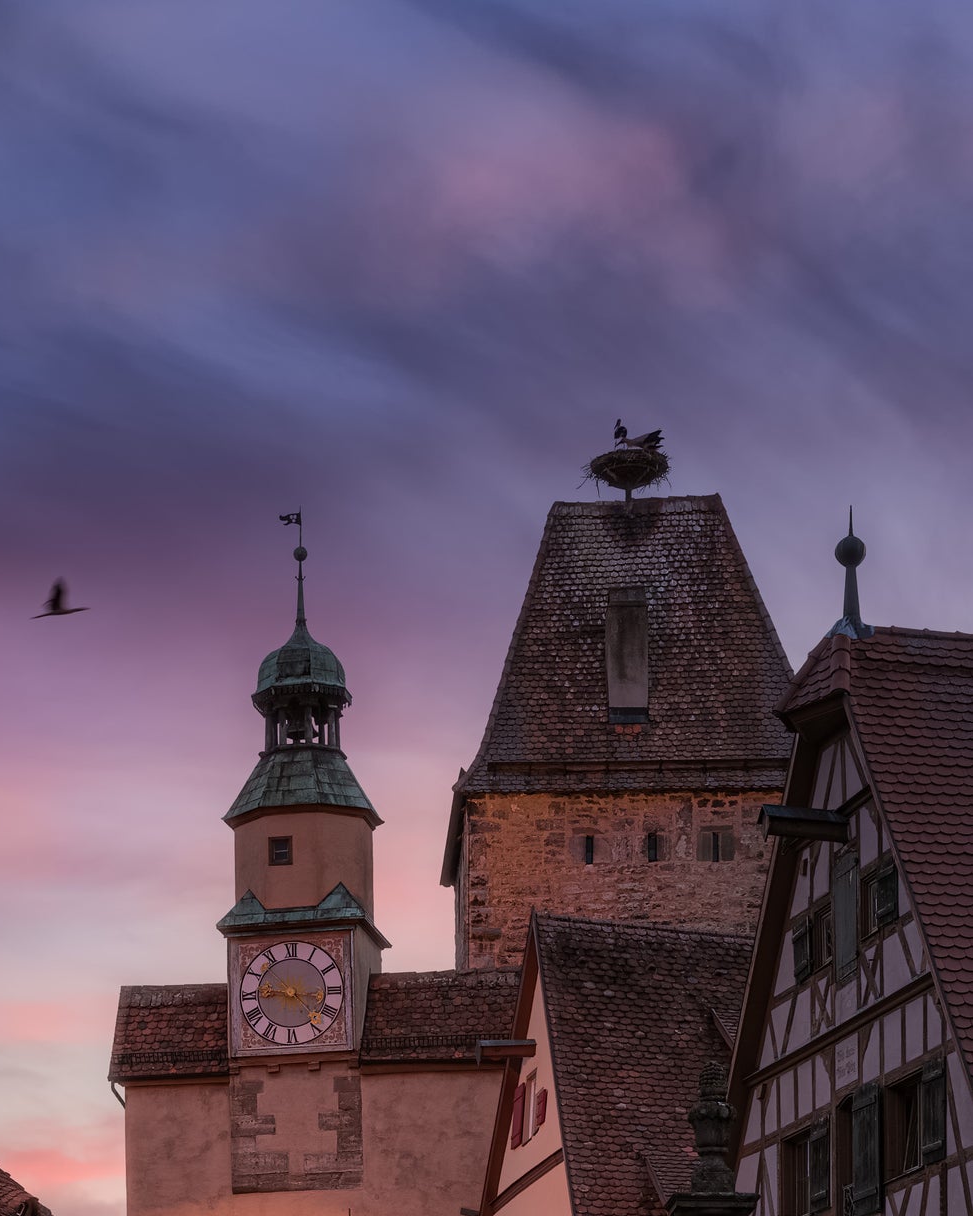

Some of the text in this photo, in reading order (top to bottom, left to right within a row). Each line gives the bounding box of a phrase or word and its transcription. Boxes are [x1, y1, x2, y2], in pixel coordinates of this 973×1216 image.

[284, 943, 298, 958] XII
[247, 968, 262, 980] X
[321, 962, 336, 976] II
[242, 991, 257, 1001] IX
[327, 986, 342, 995] III
[246, 1007, 263, 1027] VIII
[262, 1023, 277, 1040] VII
[287, 1029, 298, 1043] VI
